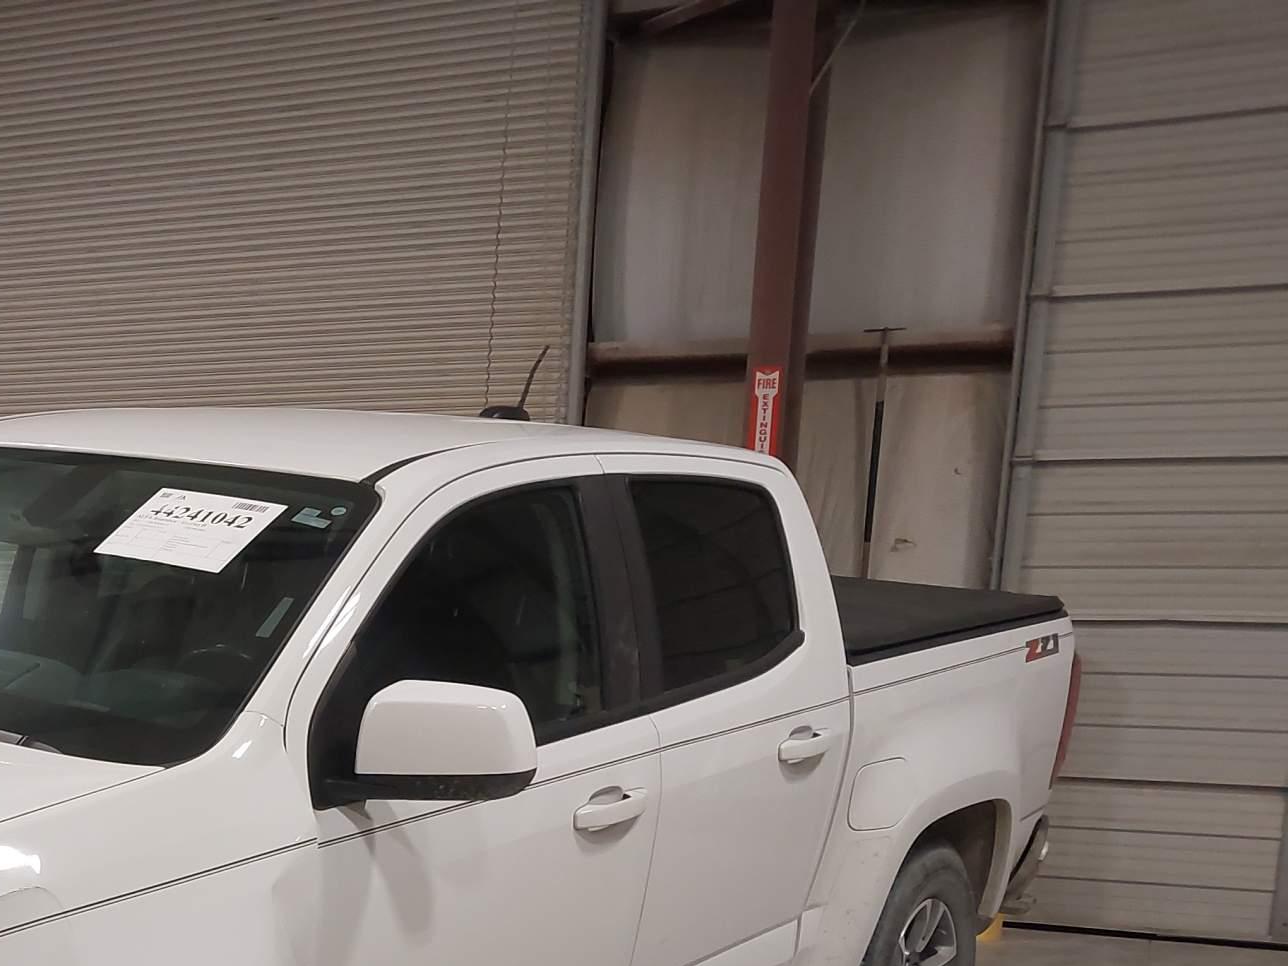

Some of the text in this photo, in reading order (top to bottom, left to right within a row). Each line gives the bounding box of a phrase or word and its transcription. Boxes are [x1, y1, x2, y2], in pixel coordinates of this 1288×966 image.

[757, 377, 777, 390] FIRE
[151, 503, 253, 529] 44241042
[1025, 633, 1059, 663] Z71
